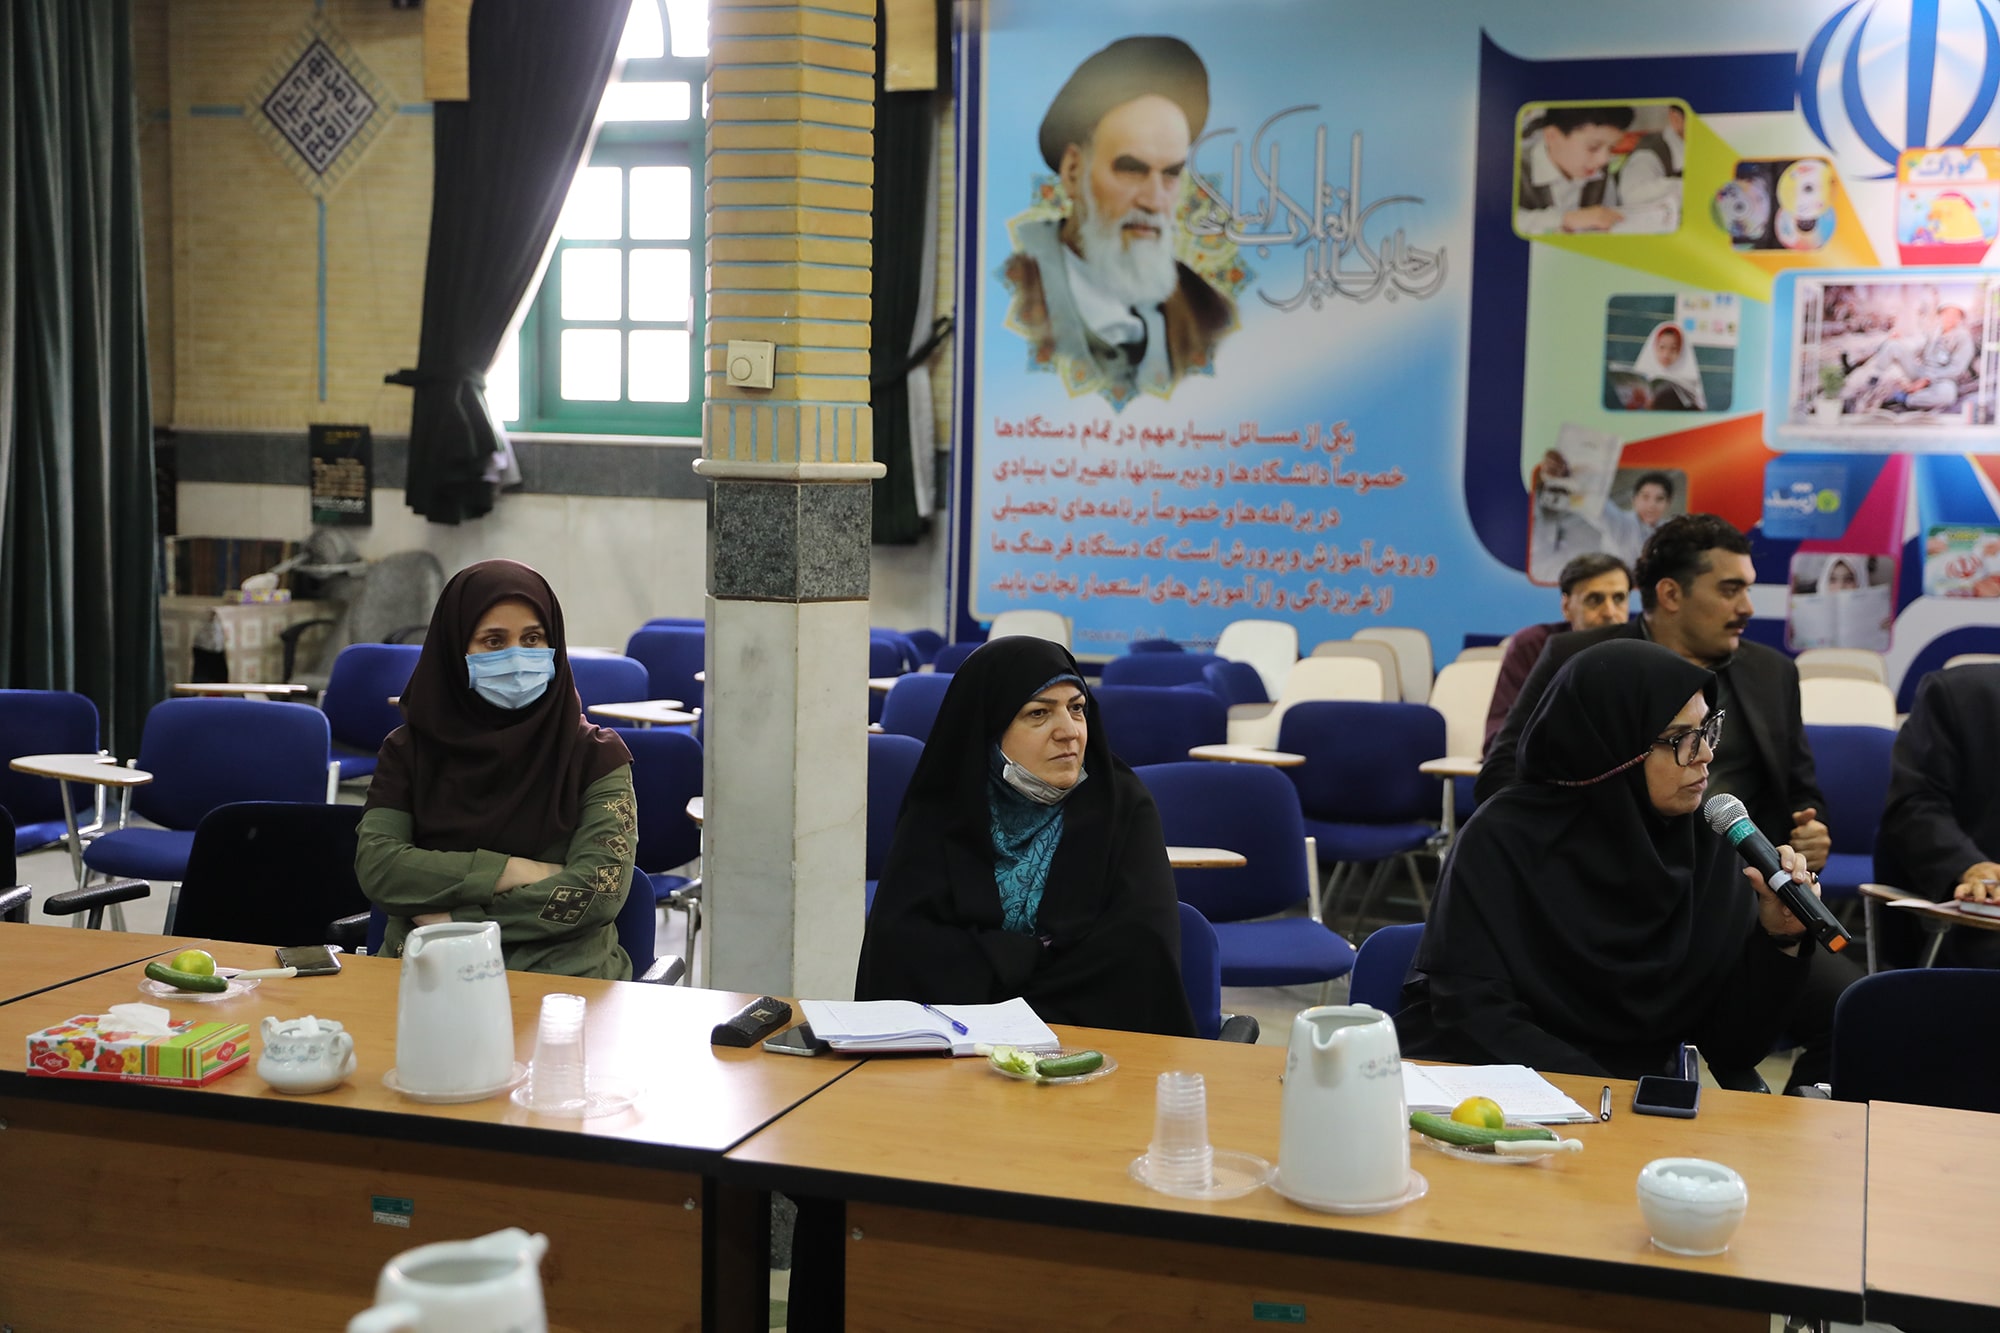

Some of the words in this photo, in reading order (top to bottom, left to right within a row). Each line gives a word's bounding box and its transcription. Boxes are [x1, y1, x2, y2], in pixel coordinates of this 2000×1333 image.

[1081, 419, 1111, 449] تمام
[1116, 425, 1135, 445] در
[1141, 427, 1174, 450] مهم
[1179, 421, 1225, 449] بسیار
[1304, 424, 1320, 449] از
[1324, 422, 1354, 453] یکی
[994, 457, 1046, 483] بنیادی
[1052, 457, 1116, 485] تغییرات
[1214, 470, 1224, 488] و
[1334, 456, 1405, 493] خصوصاً
[993, 495, 1056, 521] تحصیلی
[1153, 490, 1219, 526] خصوصاً
[1222, 509, 1234, 527] و
[1317, 509, 1340, 531] در
[992, 531, 1007, 551] ما
[1011, 530, 1074, 561] فرهنگ
[1078, 534, 1139, 558] دستگاه
[1144, 535, 1167, 558] که
[1221, 540, 1286, 575] پرورش
[1290, 550, 1301, 569] و
[1303, 540, 1371, 572] آموزش
[1372, 546, 1421, 575] روش
[1425, 556, 1437, 575] و
[1031, 572, 1077, 598] نجات
[1080, 572, 1148, 599] استعمار
[1255, 581, 1272, 607] از
[1275, 590, 1286, 608] و
[1374, 587, 1392, 614] از
